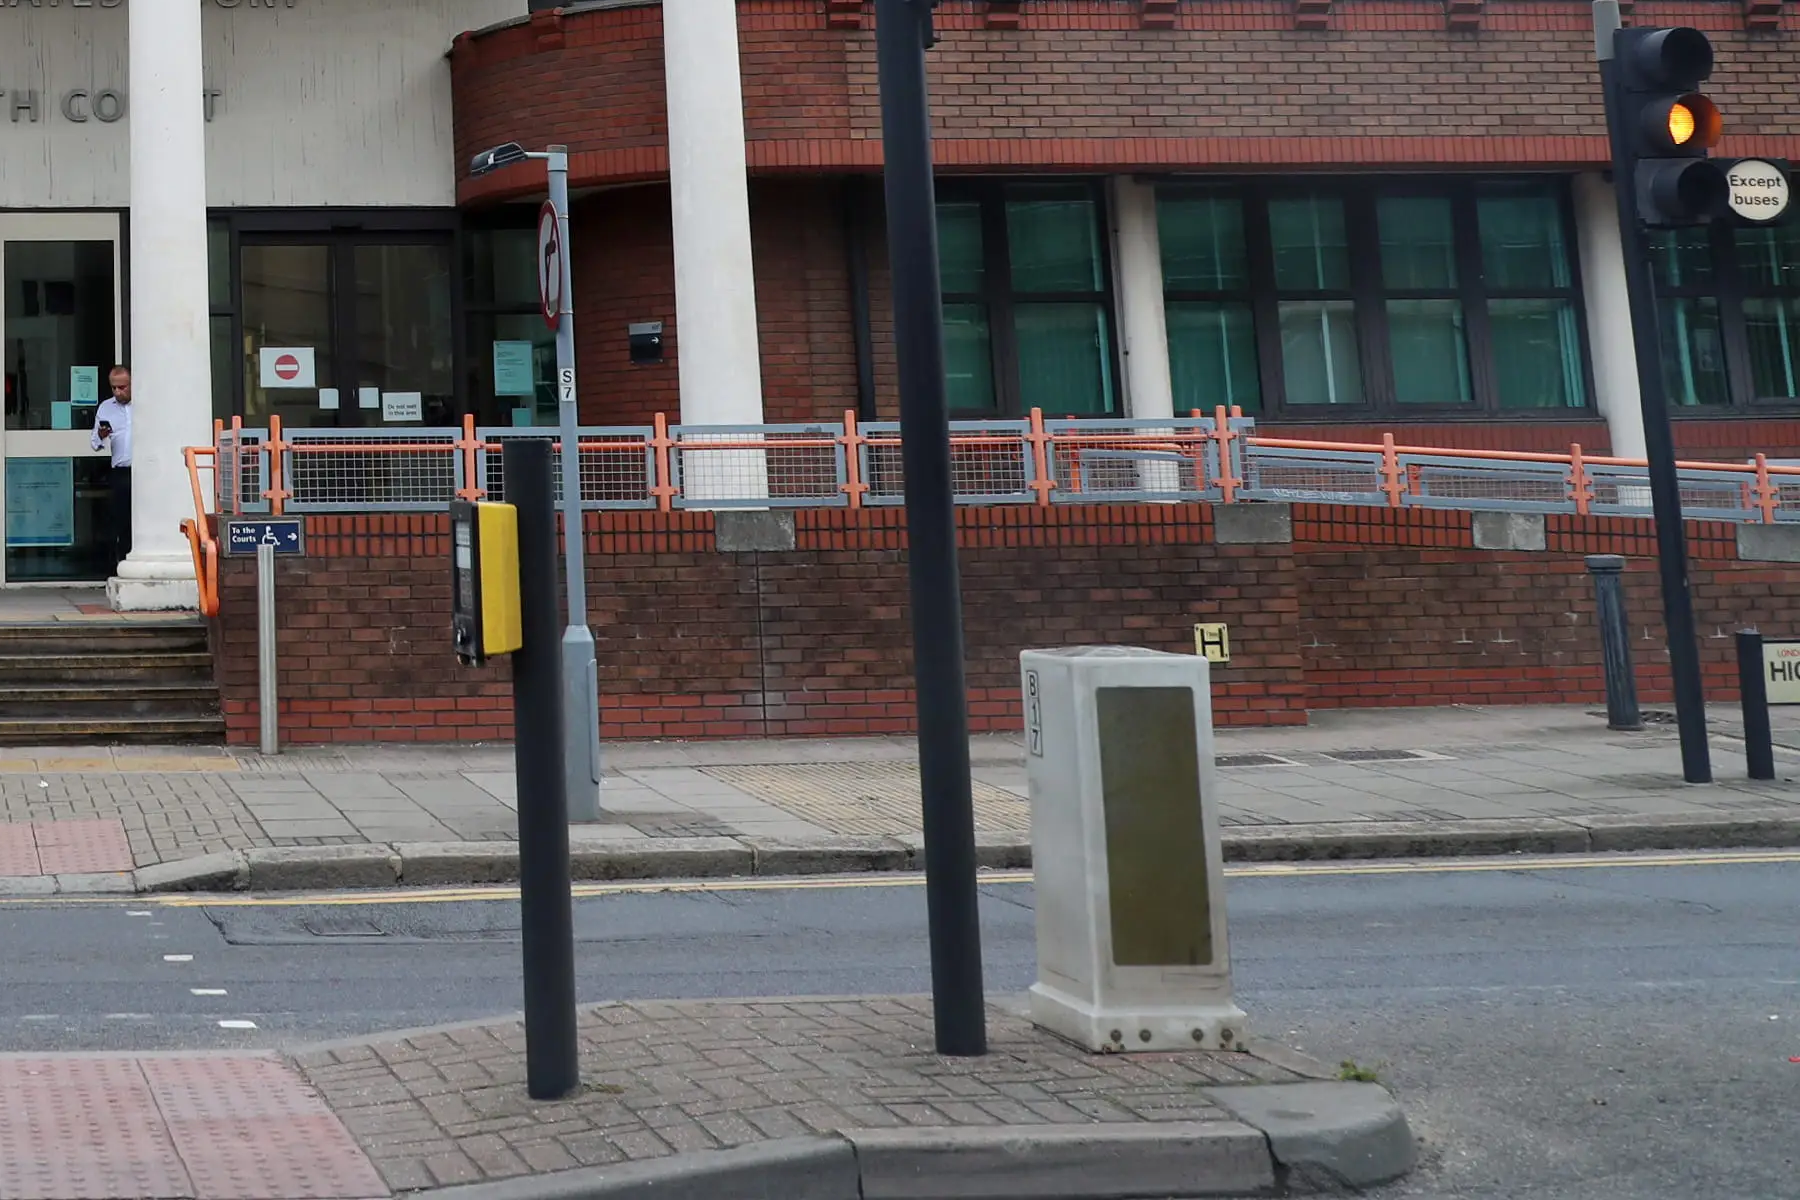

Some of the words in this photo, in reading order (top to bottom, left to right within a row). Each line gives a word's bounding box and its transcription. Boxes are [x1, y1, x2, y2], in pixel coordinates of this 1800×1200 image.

[61, 88, 222, 123] COT
[1729, 174, 1782, 189] Except
[1734, 193, 1780, 206] buses
[242, 526, 256, 534] the
[232, 535, 257, 543] Courts
[1200, 628, 1225, 658] H
